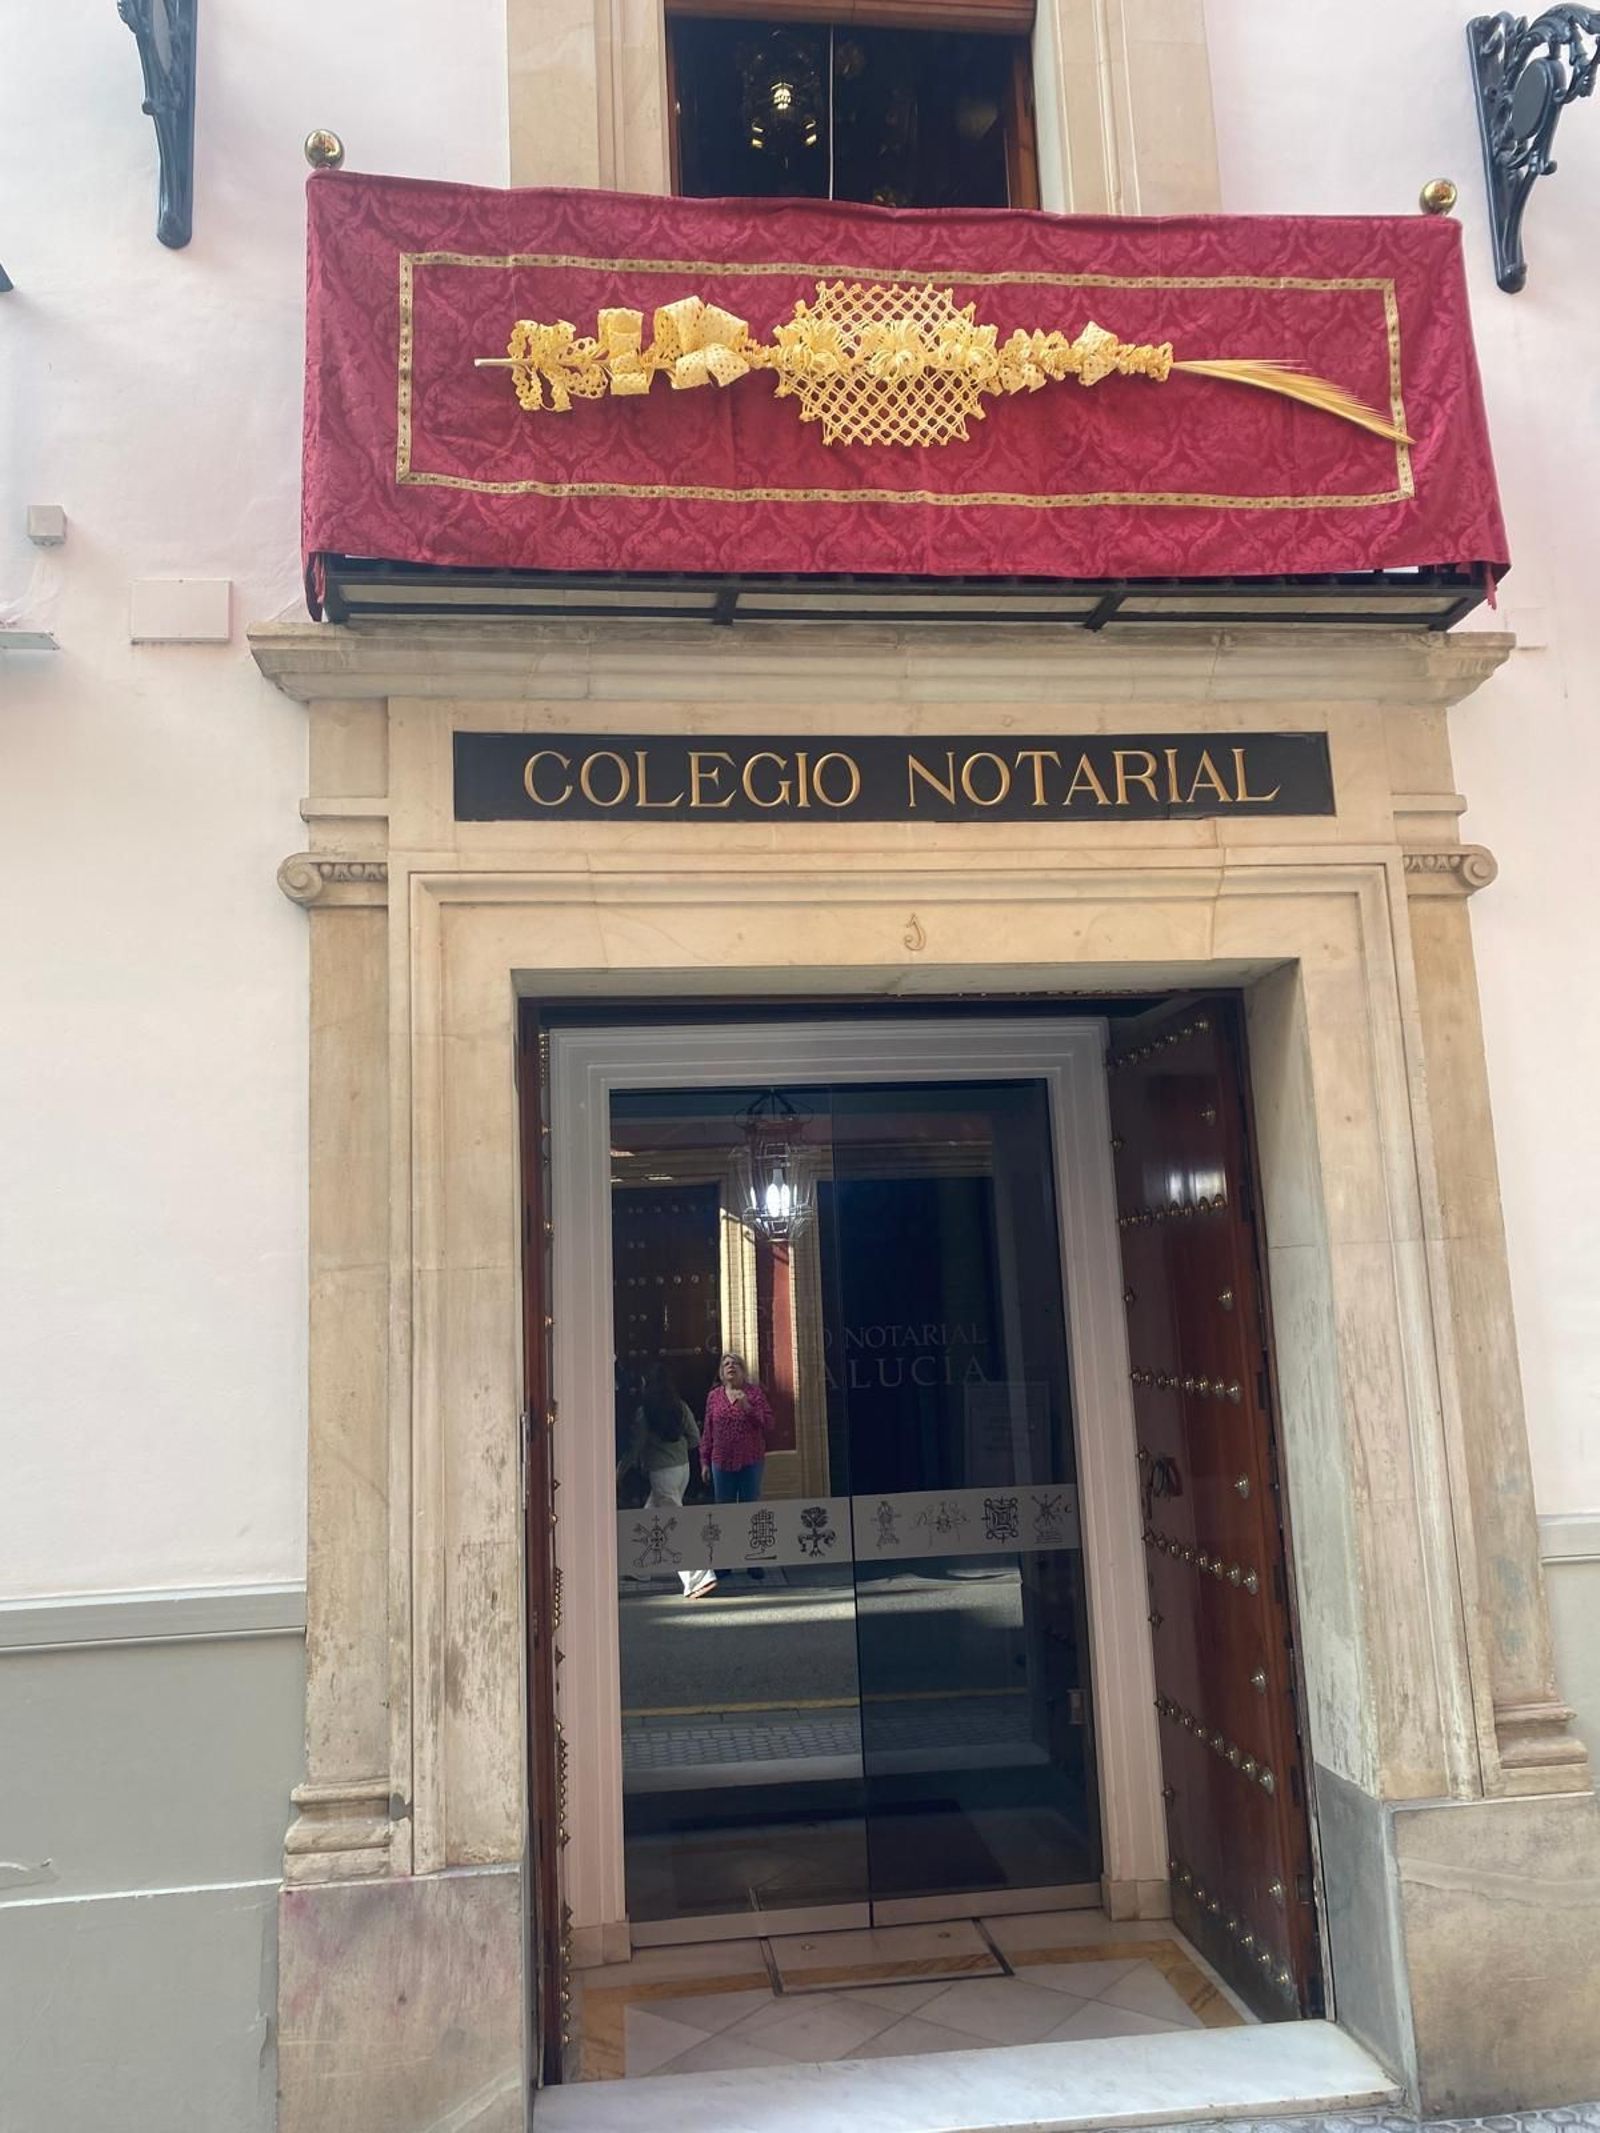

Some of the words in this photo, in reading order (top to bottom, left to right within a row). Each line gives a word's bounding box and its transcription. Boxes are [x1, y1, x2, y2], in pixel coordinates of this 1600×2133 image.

[523, 749, 862, 809] COLEGIO
[907, 747, 1282, 808] NOTARIAL
[844, 1322, 989, 1350] NOTARIAL
